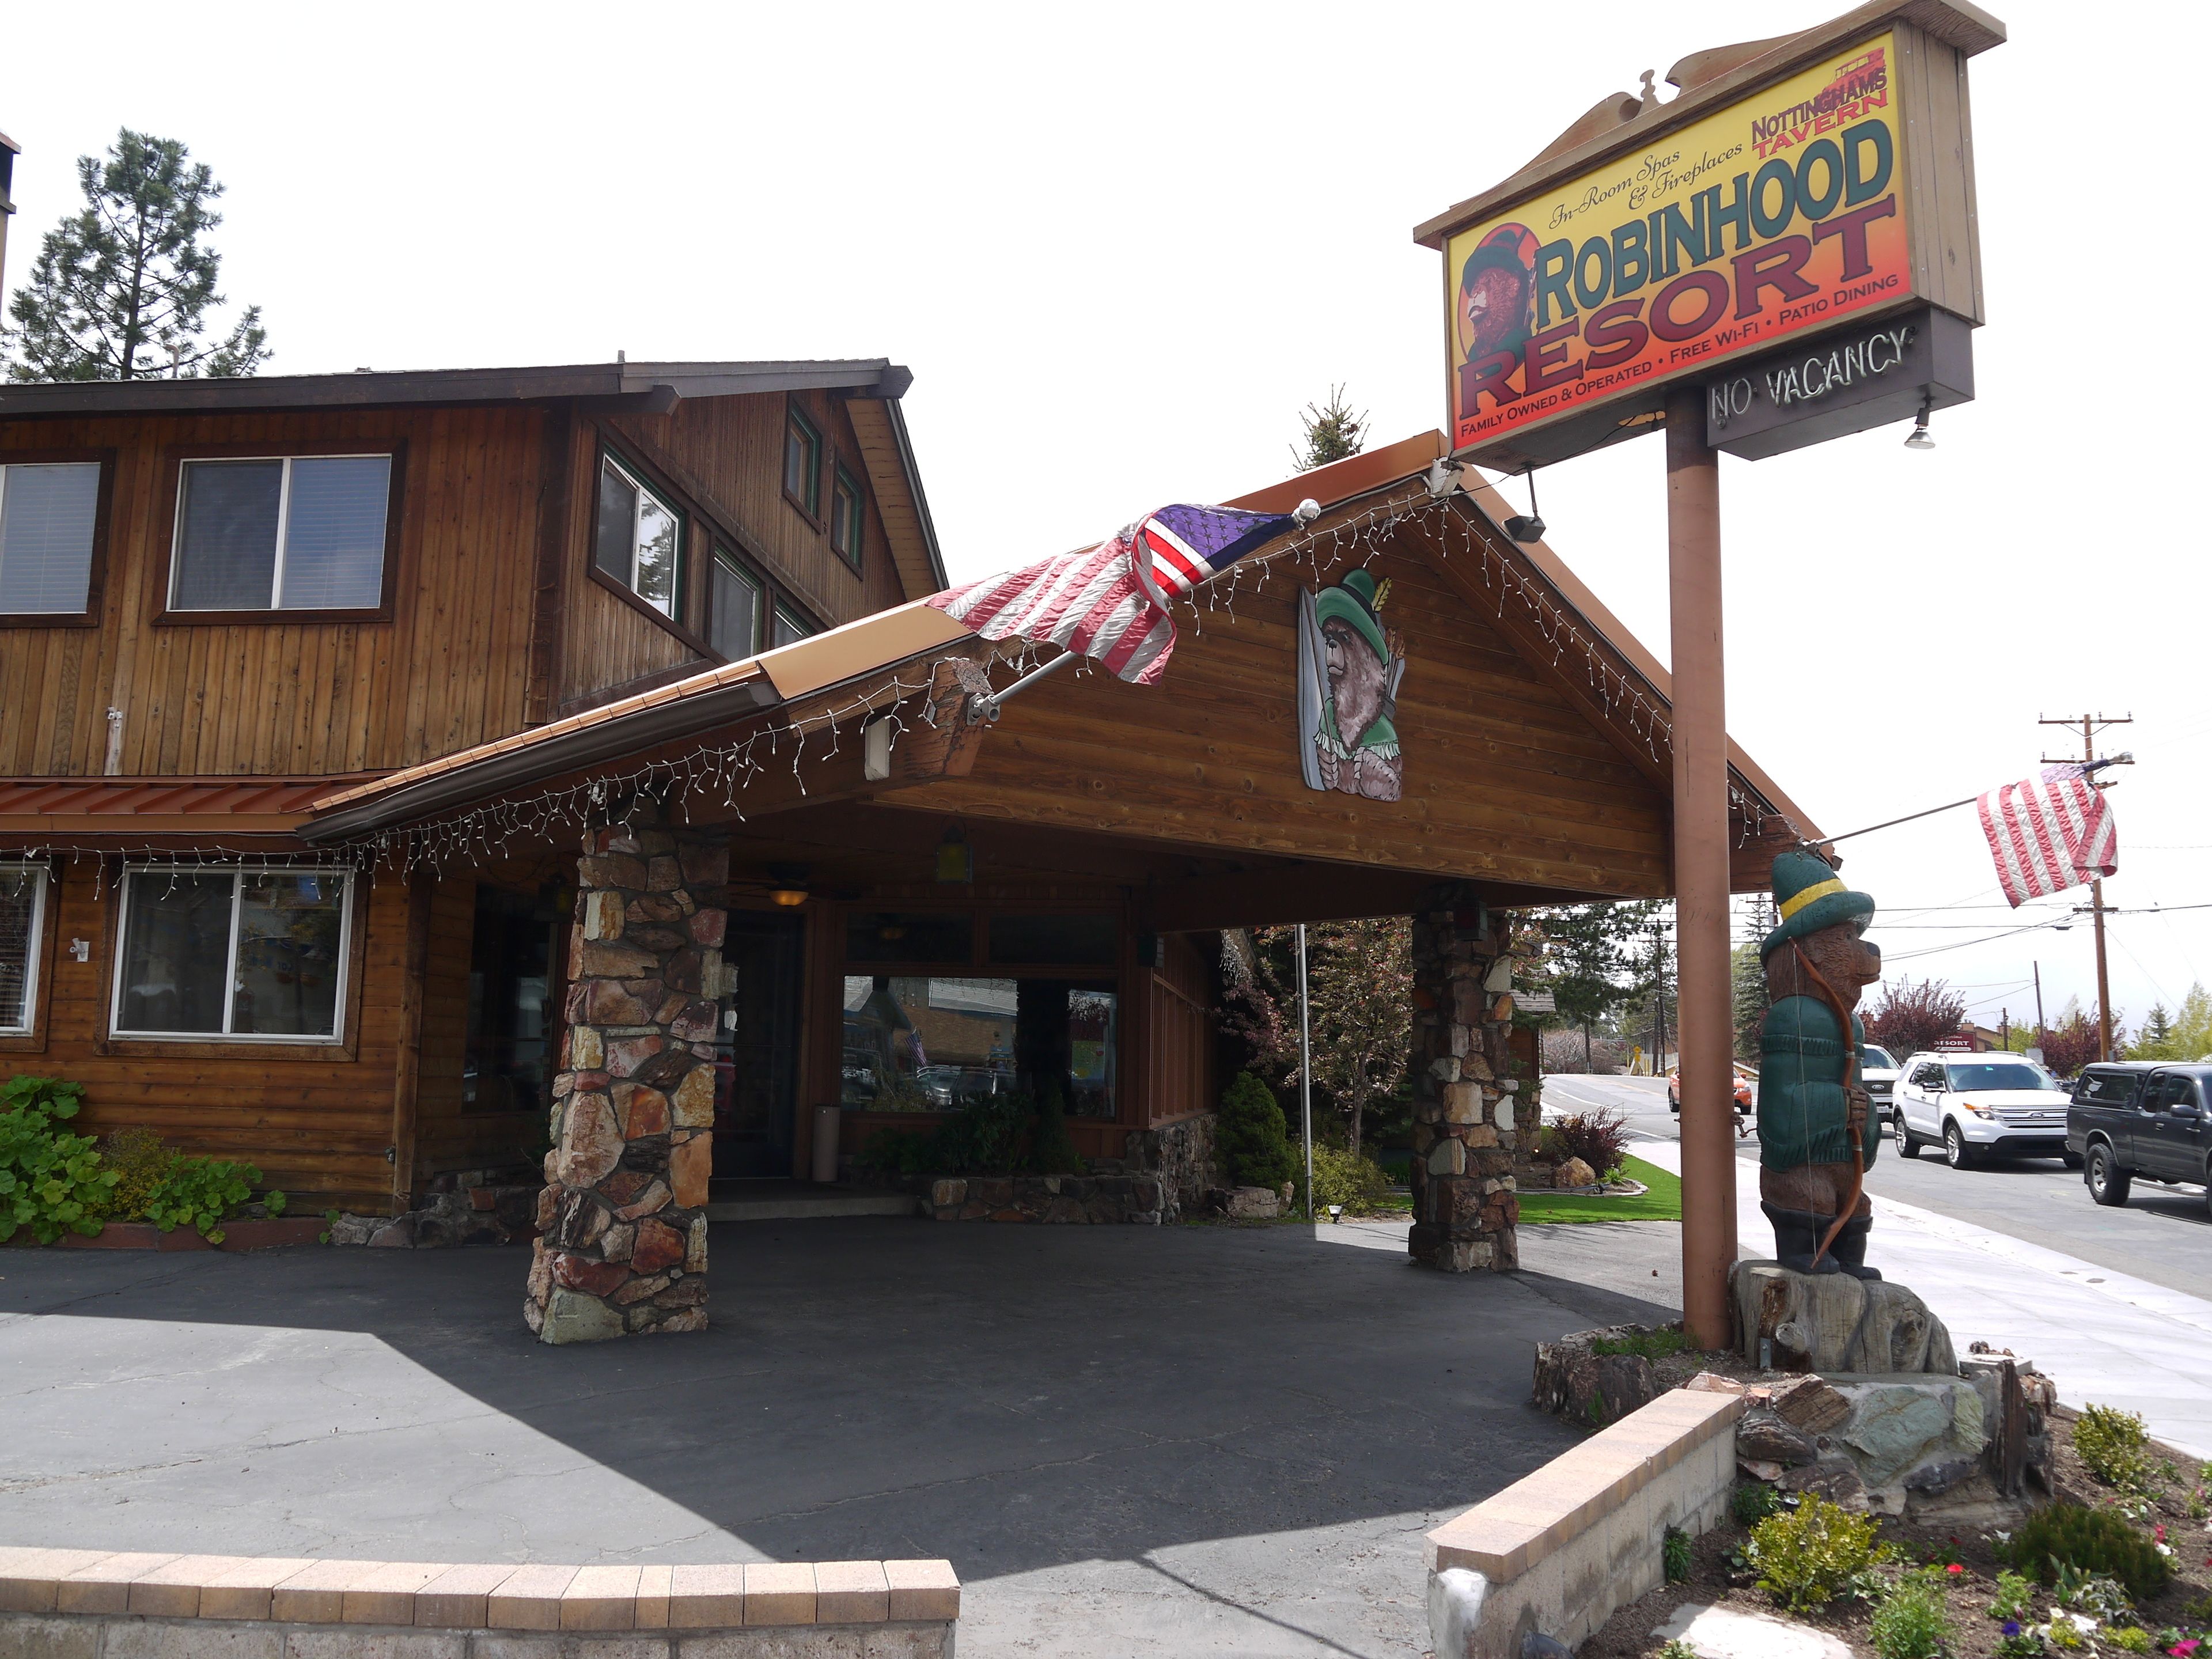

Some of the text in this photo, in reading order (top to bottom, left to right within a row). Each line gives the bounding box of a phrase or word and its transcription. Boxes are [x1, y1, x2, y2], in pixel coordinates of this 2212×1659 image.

[1752, 65, 1887, 144] NOTTINGHAMS
[1752, 88, 1888, 160] TAVERN
[1549, 150, 1680, 229] In-Room Spas
[1628, 143, 1743, 210] & Fireplaces
[1535, 118, 1893, 330] ROBINHOOD
[1458, 193, 1896, 421] RESORT
[1461, 413, 1503, 437] FAMILY
[1507, 395, 1557, 420] OWNED
[1561, 388, 1572, 401] &
[1575, 361, 1652, 396] OPERATED
[1671, 340, 1711, 363] FREE
[1779, 299, 1828, 325] PATIO
[1834, 274, 1899, 306] DINING
[1712, 327, 1910, 420] NO VACANCY
